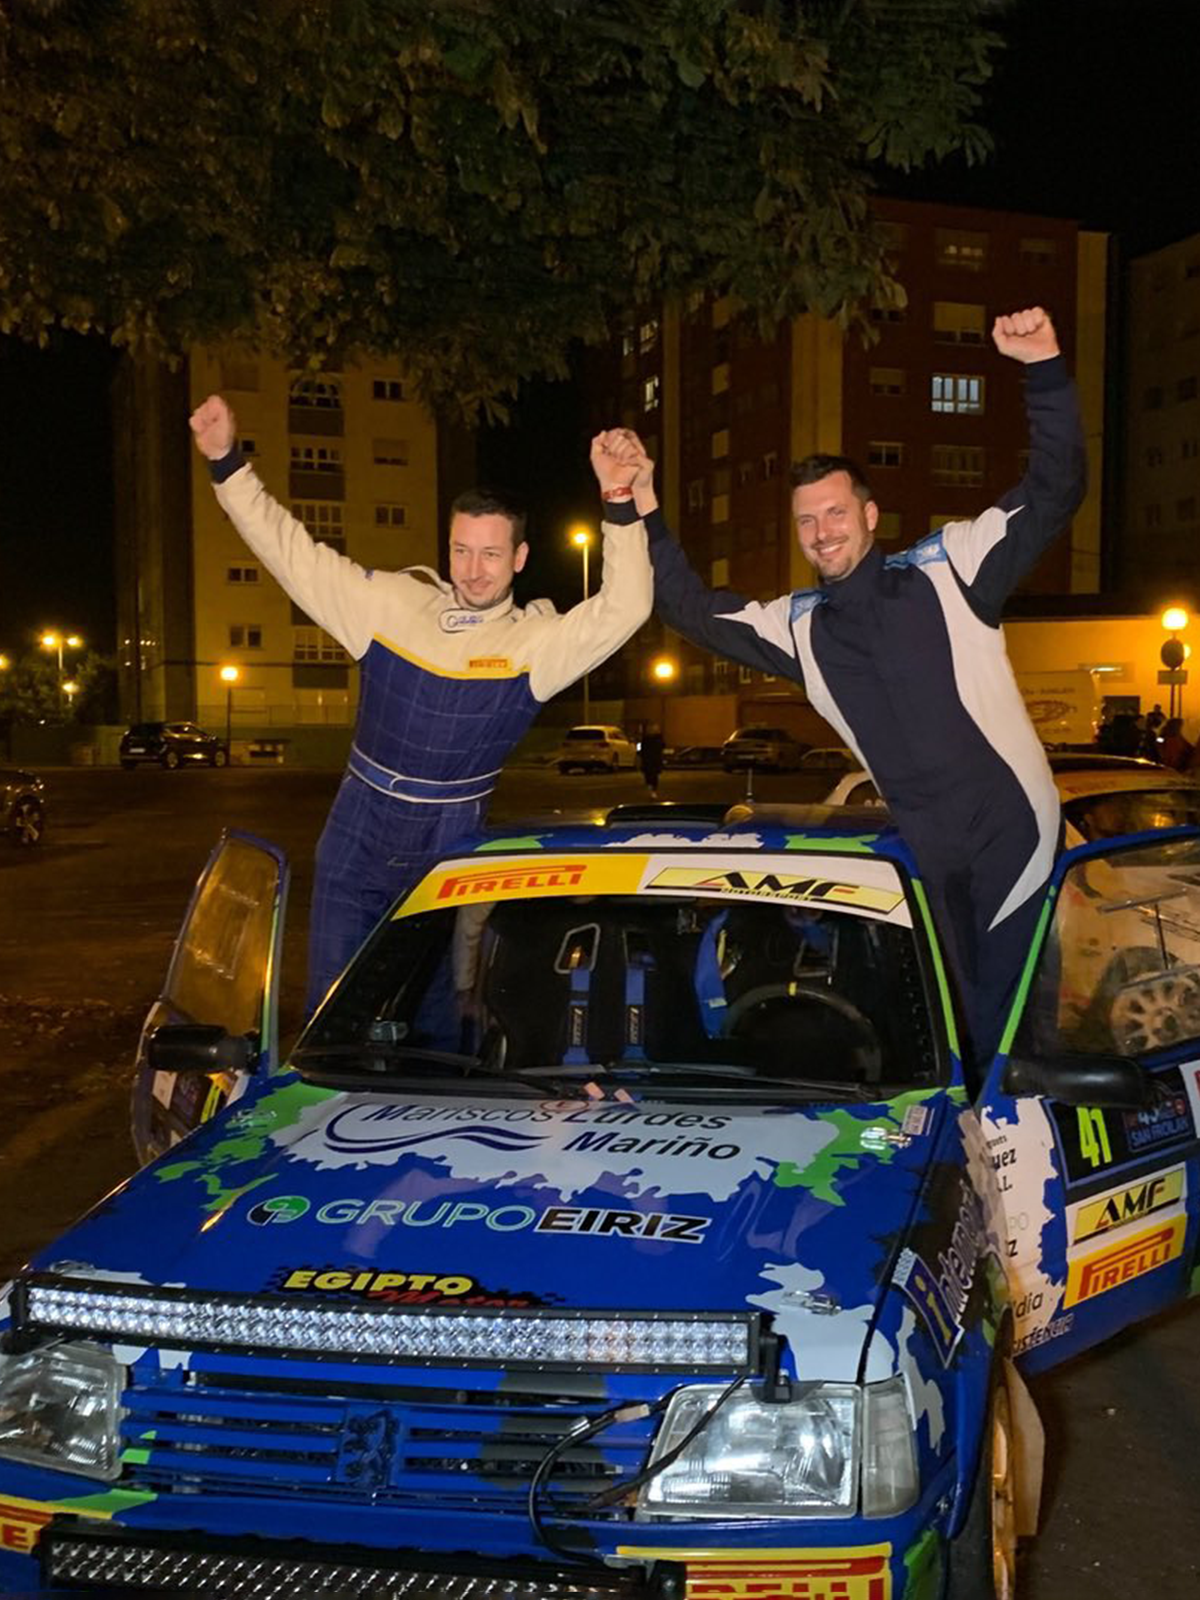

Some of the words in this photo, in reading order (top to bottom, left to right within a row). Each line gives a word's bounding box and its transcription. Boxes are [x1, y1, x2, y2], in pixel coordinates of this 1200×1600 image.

[438, 864, 587, 899] PIRELLI
[694, 871, 859, 898] AMF
[361, 1102, 553, 1124] Mariscos
[562, 1107, 732, 1130] Lurdes
[562, 1130, 741, 1160] Mariño
[1095, 1177, 1166, 1228] AMF
[315, 1199, 536, 1231] GRUPO
[534, 1205, 713, 1244] EIRIZ
[1077, 1226, 1174, 1300] PIRELLI
[284, 1269, 474, 1296] EGIPTO
